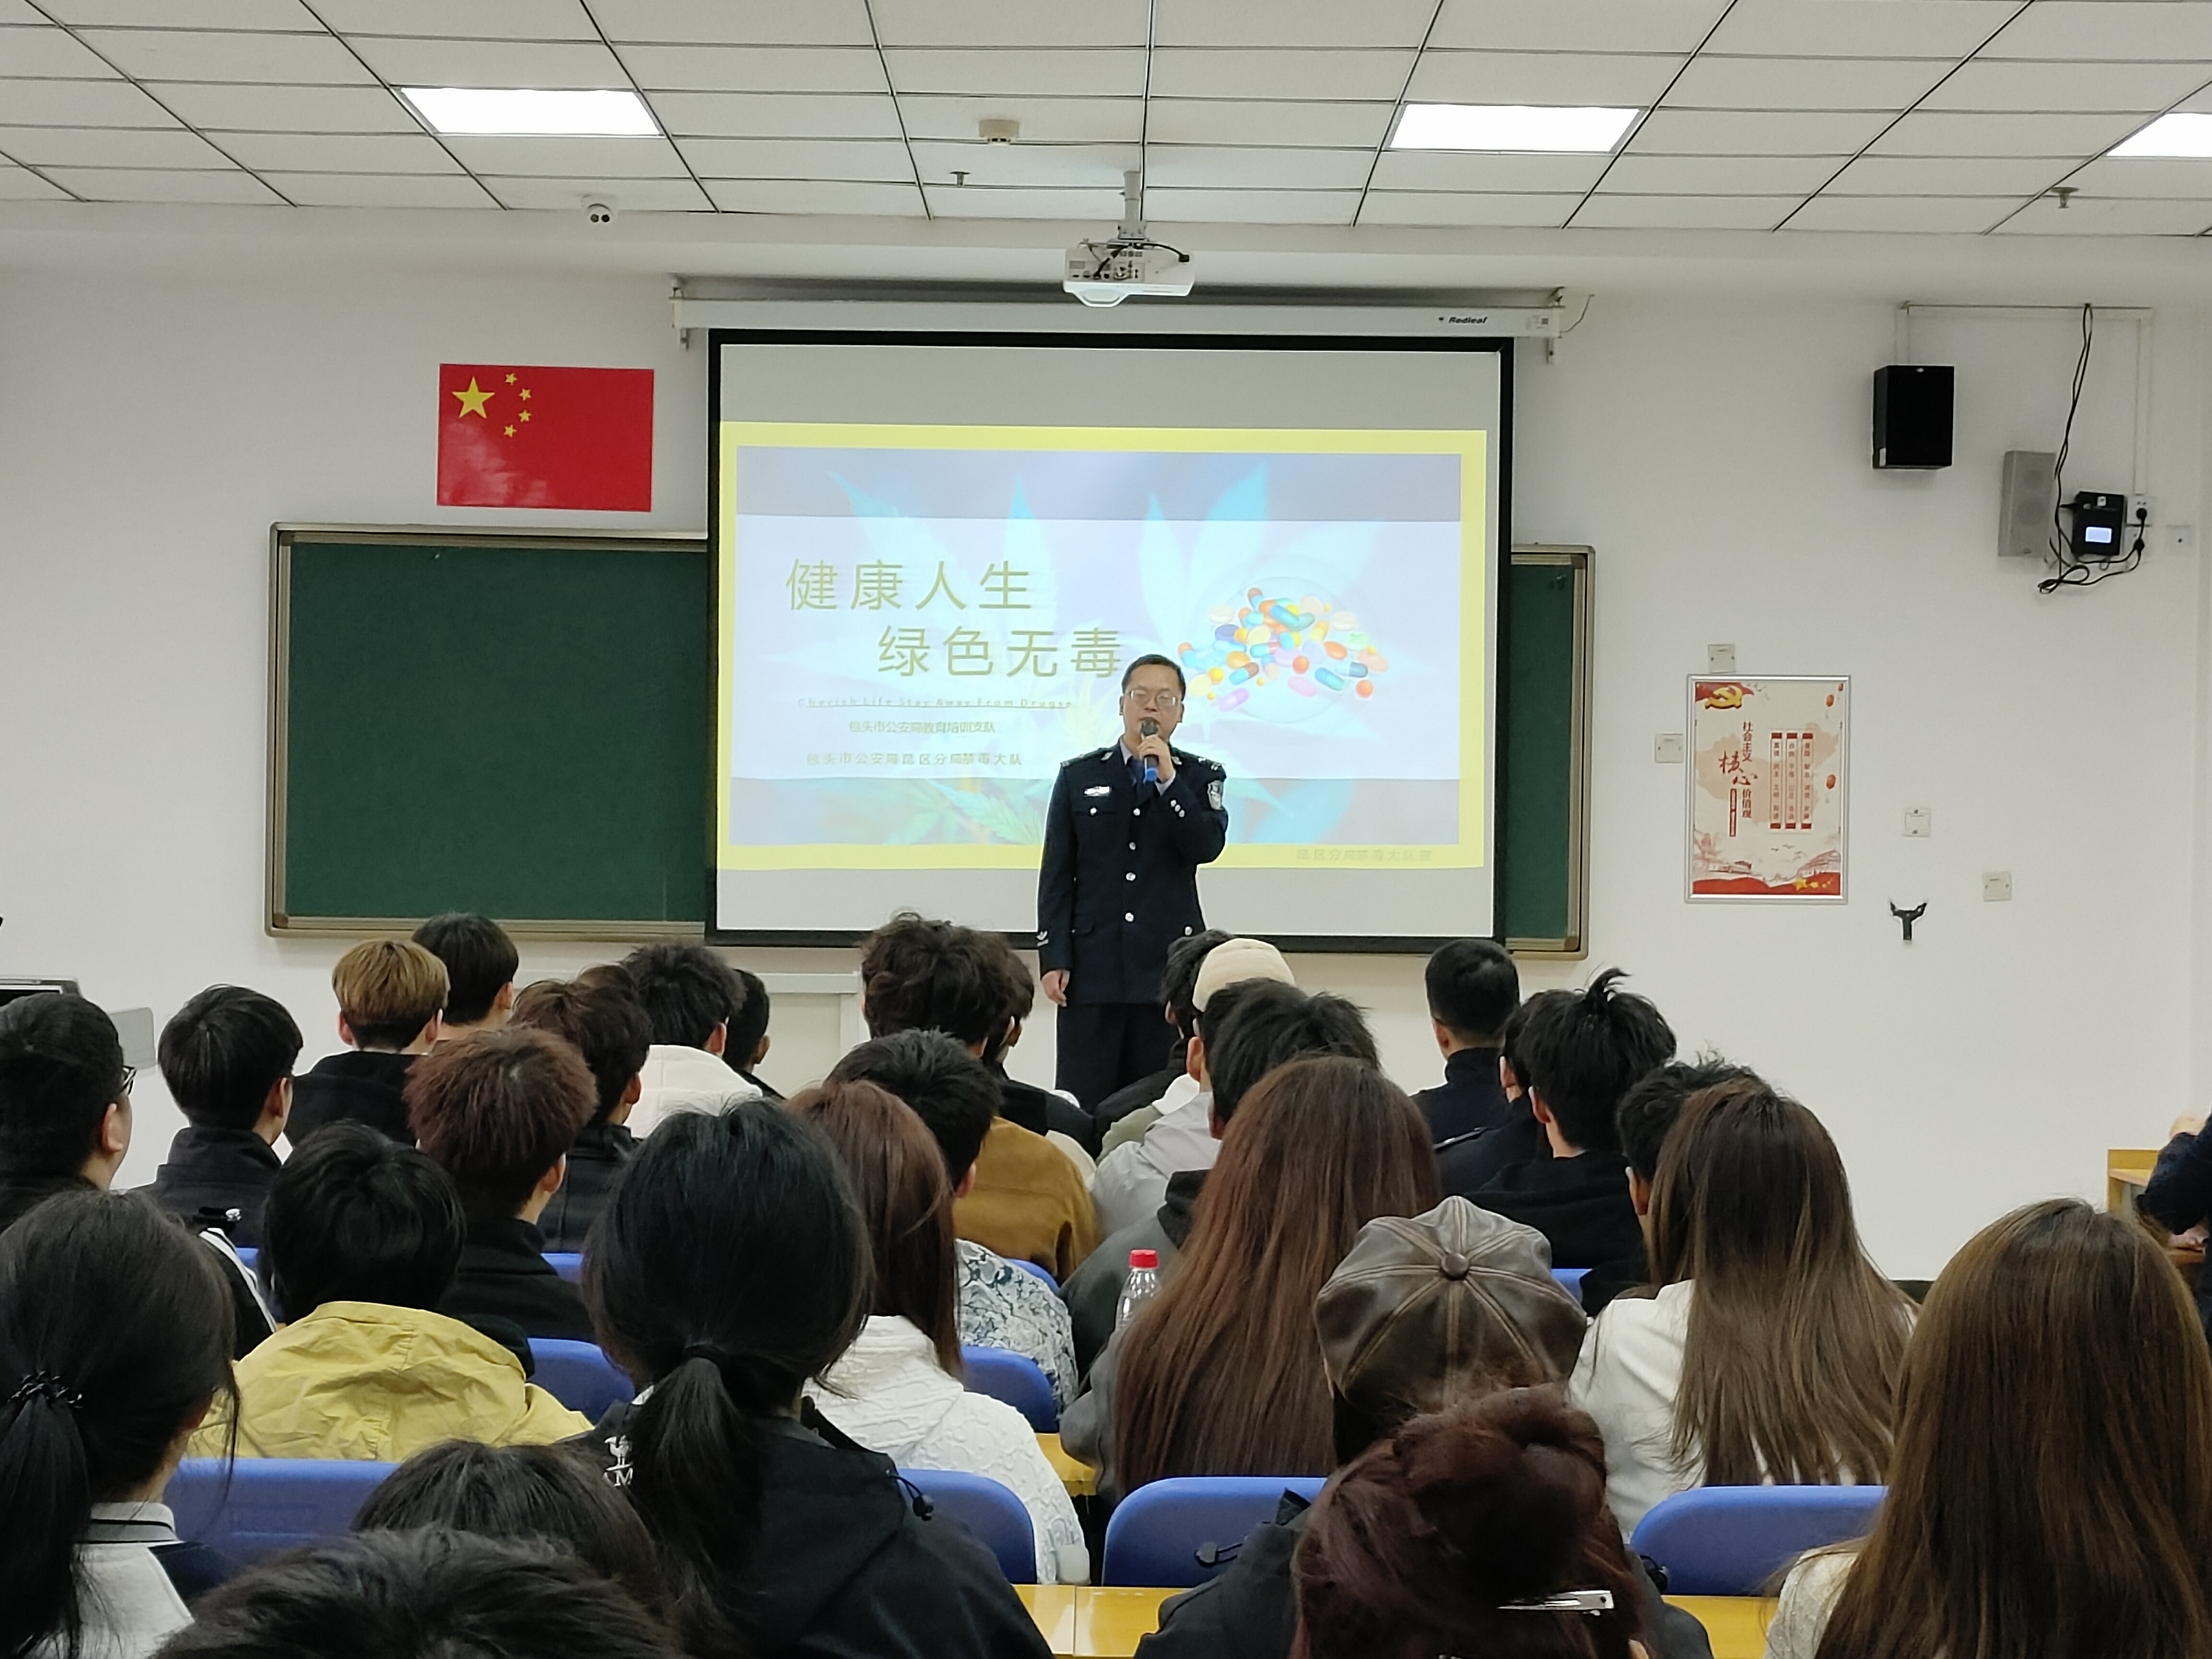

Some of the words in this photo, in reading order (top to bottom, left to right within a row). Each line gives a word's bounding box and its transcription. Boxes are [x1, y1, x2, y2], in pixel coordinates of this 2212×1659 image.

[786, 559, 1032, 611] 健康人生
[878, 625, 1121, 677] 绿色无毒
[797, 697, 856, 707] Cherish
[864, 697, 893, 706] Life
[899, 698, 930, 707] Stay
[936, 698, 970, 707] Away
[849, 721, 996, 733] 包头市公安局教育培训支队
[1742, 721, 1754, 762] 社会主义
[806, 753, 1022, 765] 包头市公安局昆区分局禁毒大队
[1718, 750, 1758, 785] 核心
